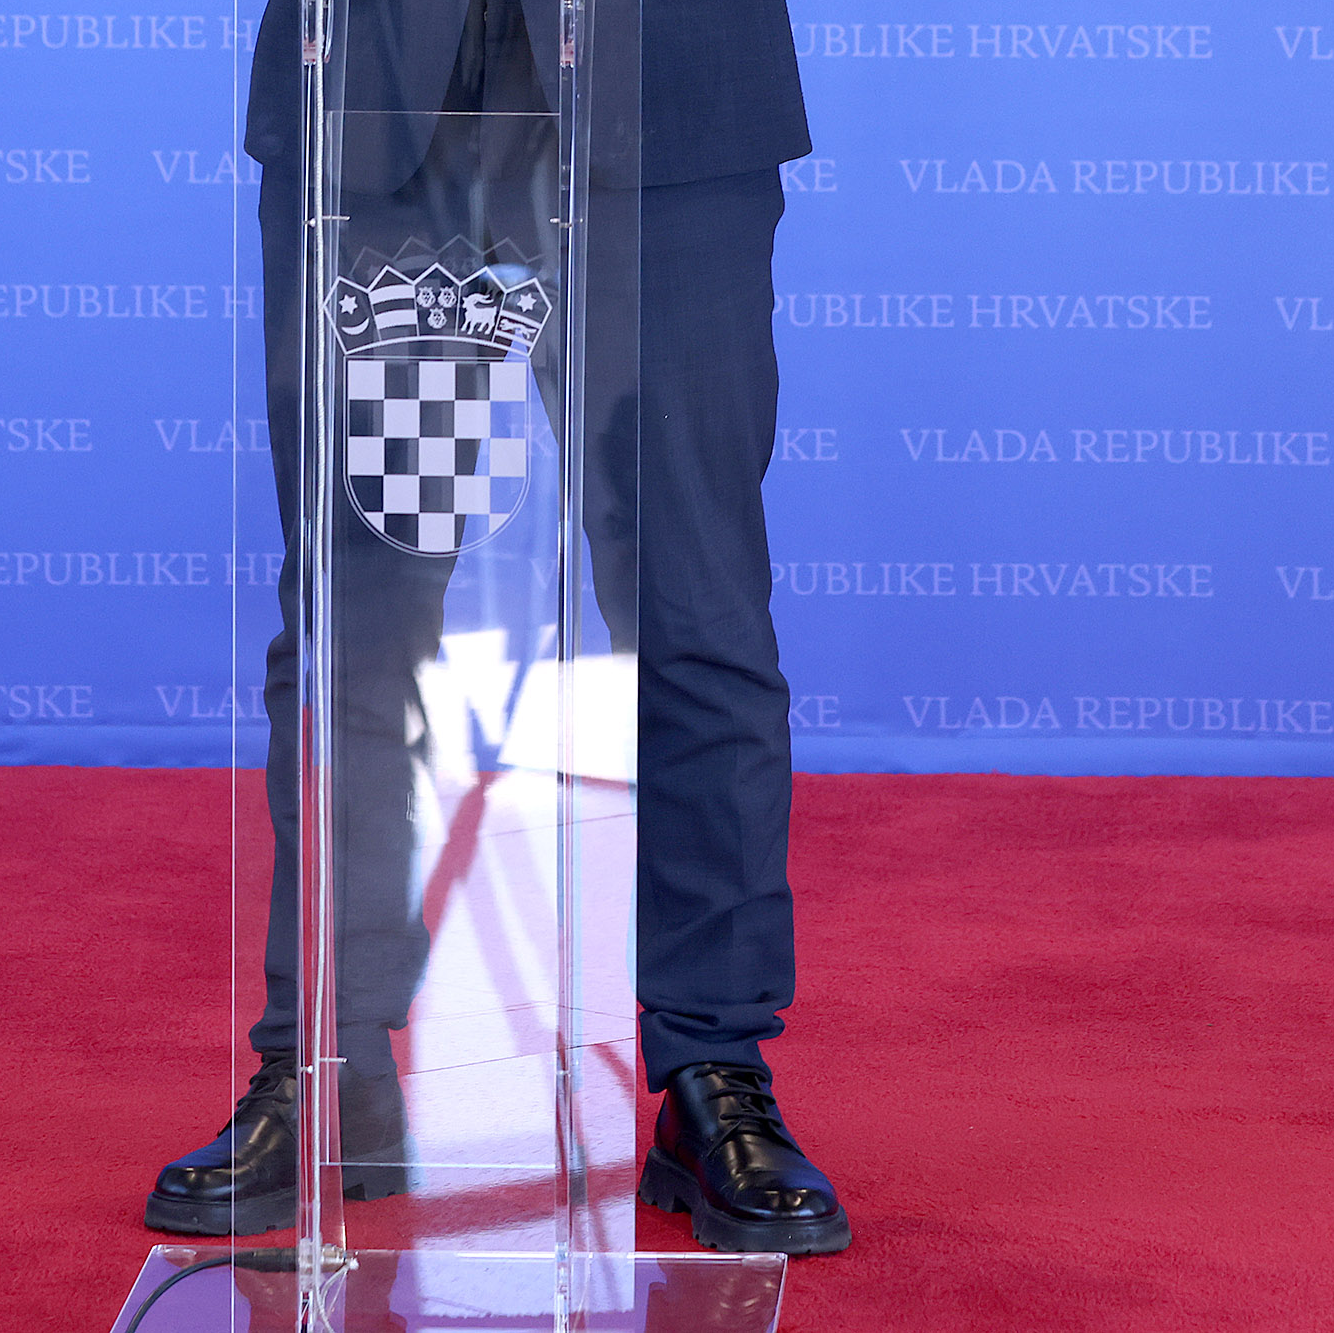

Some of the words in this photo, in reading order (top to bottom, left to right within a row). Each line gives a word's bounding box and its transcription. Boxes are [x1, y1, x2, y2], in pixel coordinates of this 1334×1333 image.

[793, 23, 956, 58] UBLIKE
[966, 24, 1214, 60] HRVATSKE
[150, 149, 261, 185] VLA
[897, 158, 1059, 194] VLADA
[1069, 159, 1331, 196] REPUBLIKE
[967, 294, 1213, 330] HRVATSKE
[899, 428, 1060, 463] VLADA
[1070, 429, 1332, 466] REPUBLIKE
[968, 562, 1215, 598] HRVATSKE
[900, 695, 1061, 730] VLADA
[1073, 696, 1334, 734] REPUBLIKE
